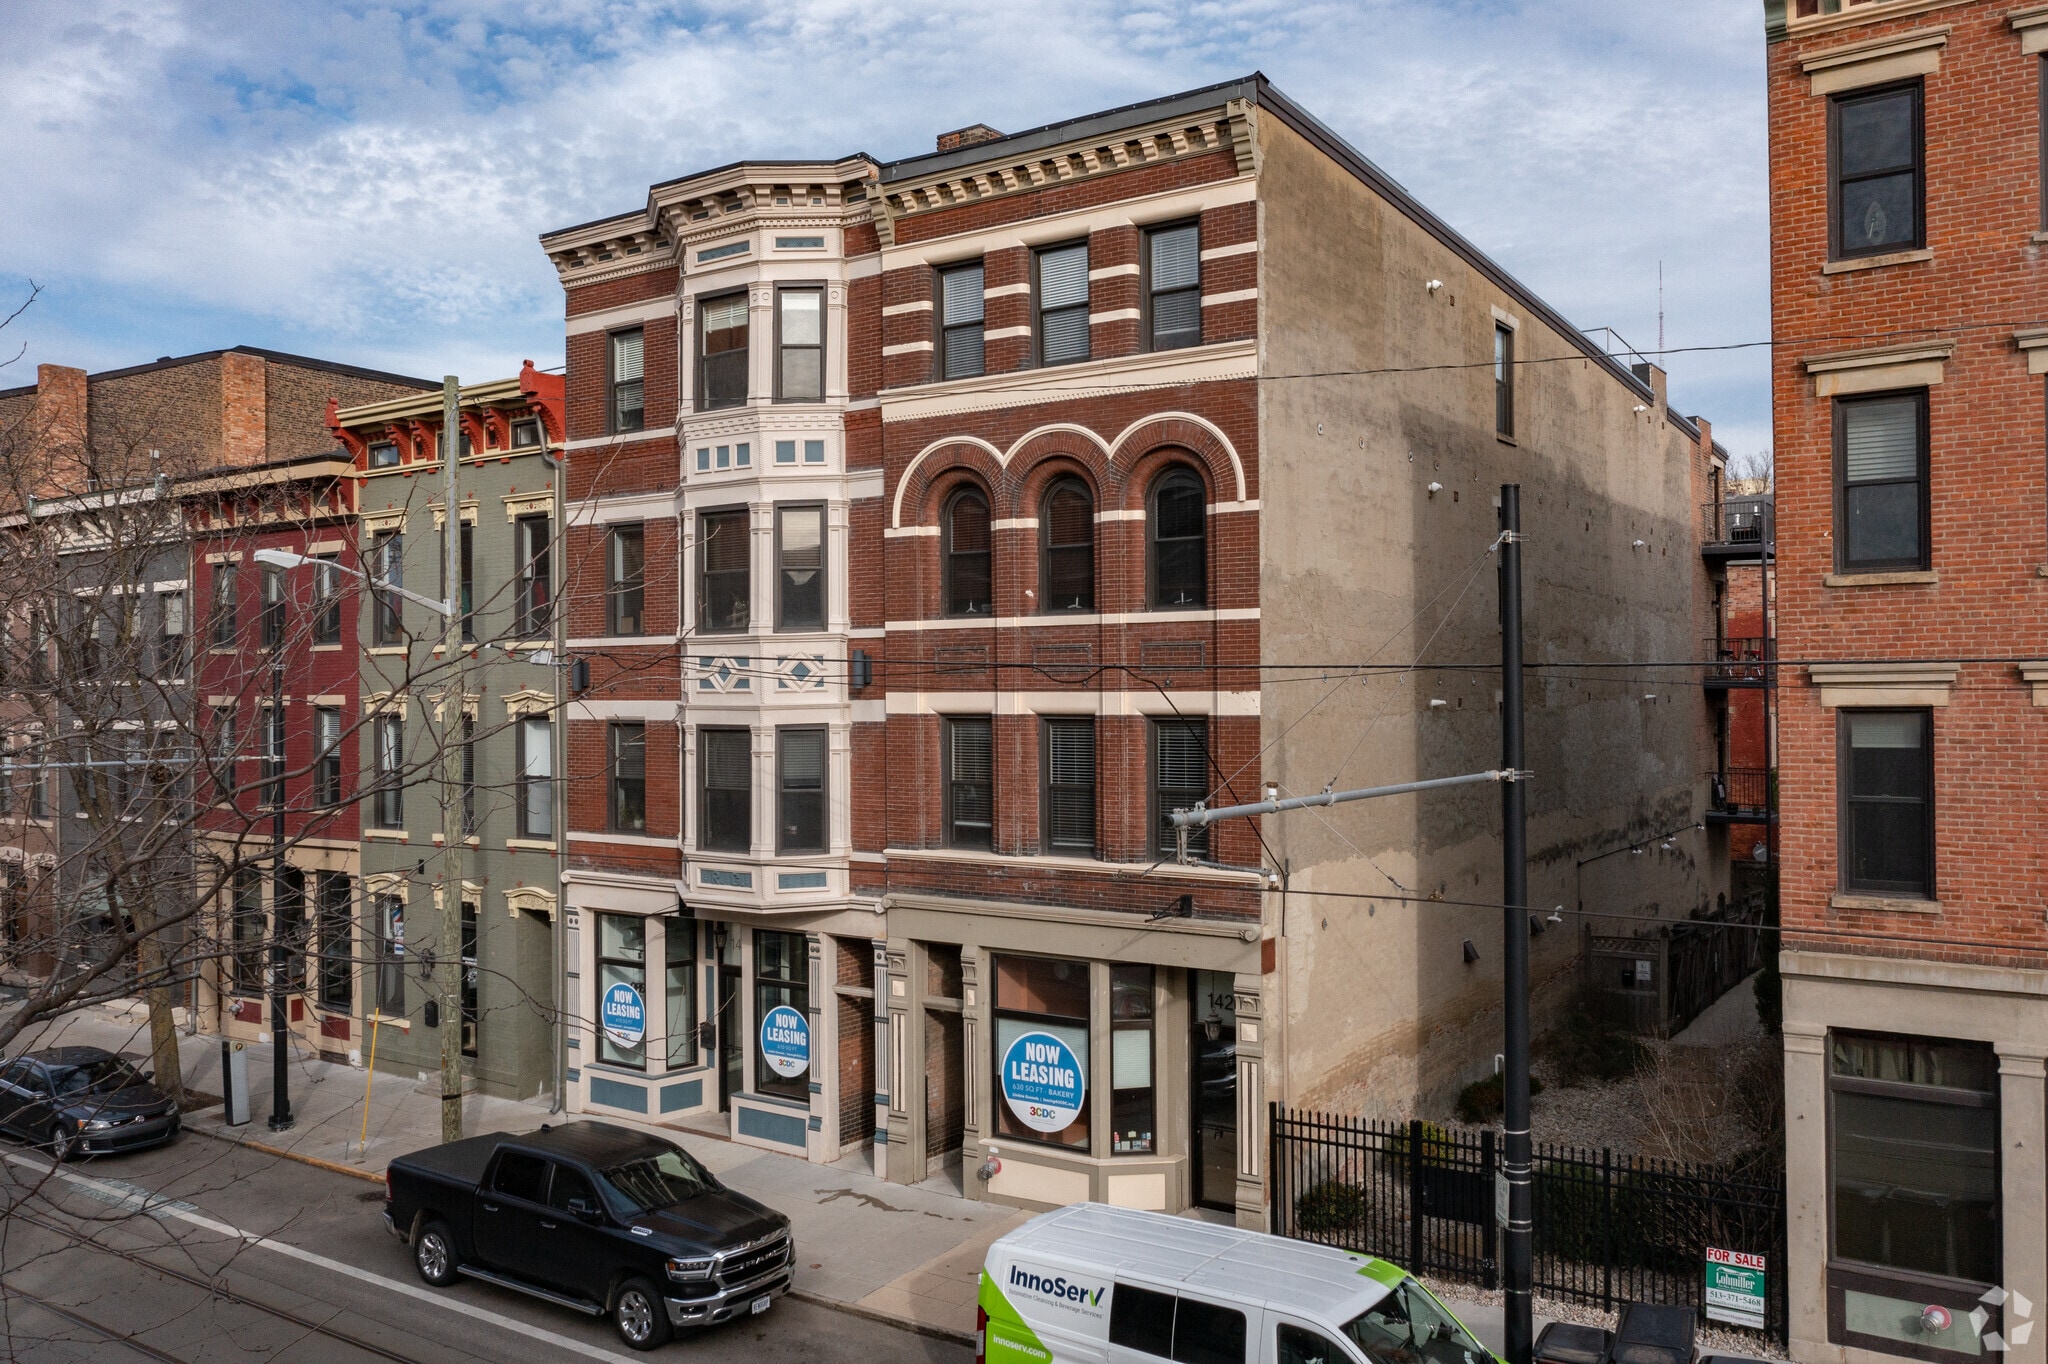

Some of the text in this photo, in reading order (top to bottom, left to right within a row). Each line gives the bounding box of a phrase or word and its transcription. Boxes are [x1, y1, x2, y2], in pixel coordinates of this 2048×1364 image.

[614, 990, 632, 1004] NOW
[607, 1002, 640, 1020] LEASING
[776, 1013, 798, 1030] NOW
[767, 1026, 806, 1046] LEASING
[1026, 1042, 1060, 1064] NOW
[778, 1058, 795, 1068] 3CDC
[1012, 1060, 1074, 1088] LEASING
[1048, 1088, 1074, 1099] BAKERY
[1030, 1106, 1056, 1120] 3CDC
[746, 1252, 774, 1267] RAM
[1708, 1249, 1764, 1268] FOR SALE
[1716, 1272, 1755, 1290] Lohmiller
[1008, 1288, 1032, 1299] Innovative
[1032, 1294, 1053, 1306] Cleaning
[1058, 1302, 1080, 1313] Beverage
[1081, 1307, 1102, 1319] Services
[1710, 1290, 1761, 1306] 513-371-5468
[993, 1334, 1046, 1360] innoserv.com
